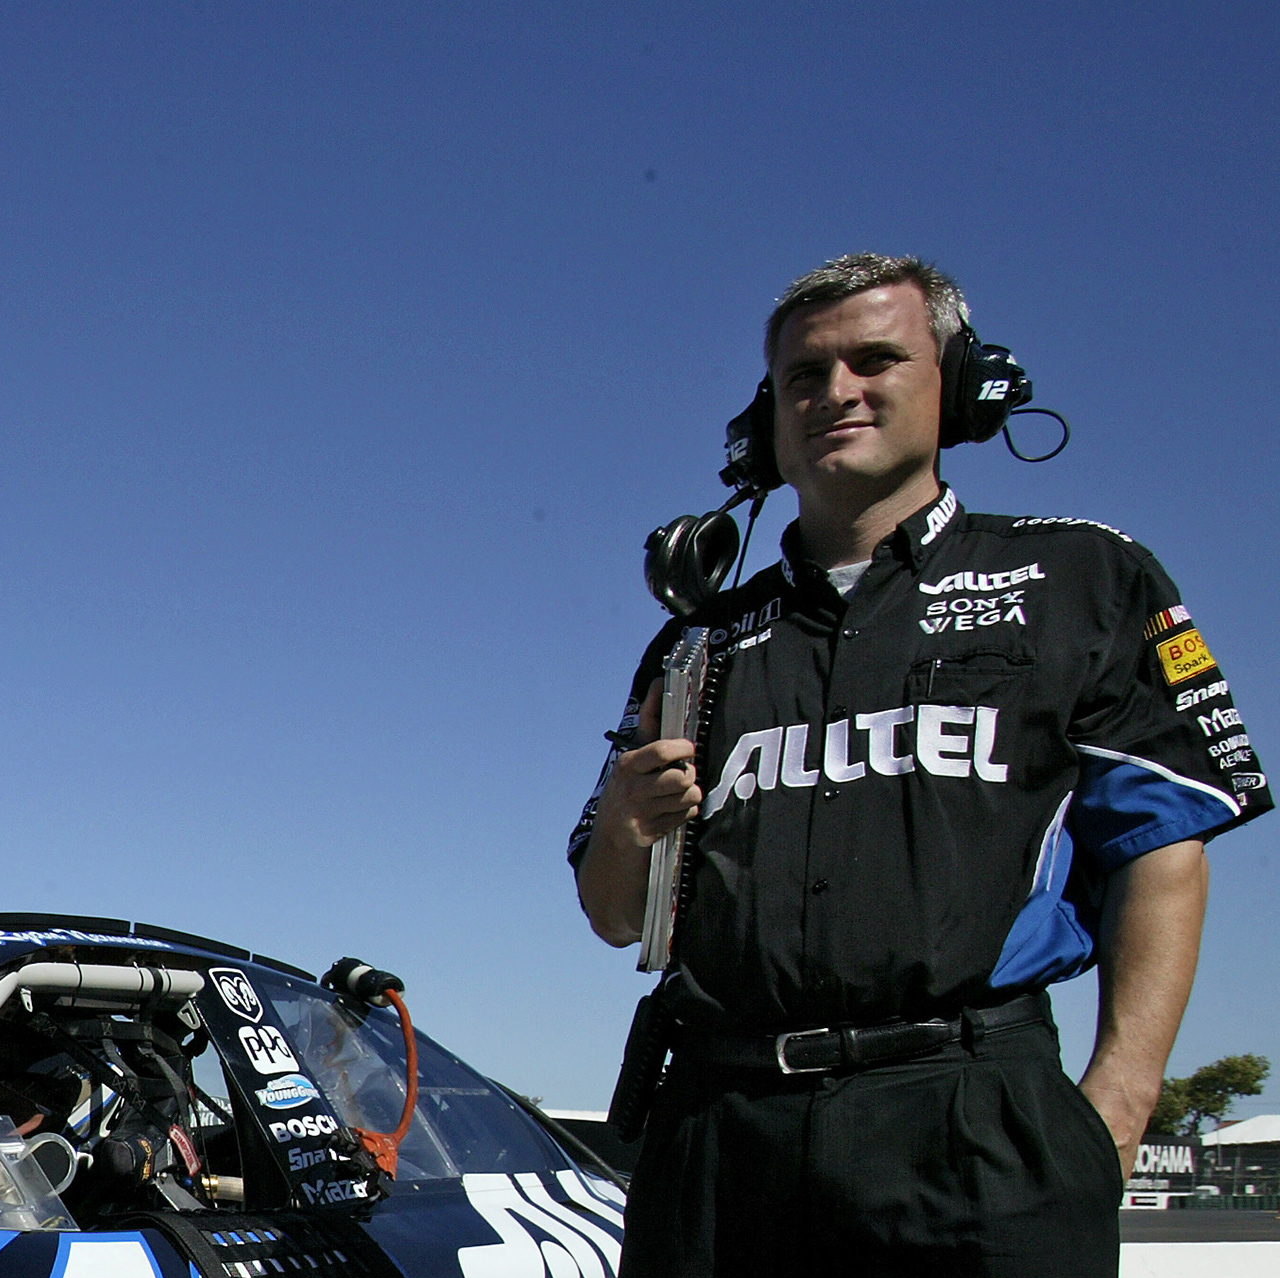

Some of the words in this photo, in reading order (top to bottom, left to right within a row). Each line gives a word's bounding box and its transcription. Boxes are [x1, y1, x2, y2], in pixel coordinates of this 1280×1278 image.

[978, 380, 1010, 400] 12
[918, 562, 1045, 595] ALLTEL
[918, 605, 1026, 634] WEGA
[1169, 635, 1206, 660] BOS
[703, 705, 1009, 820] ALLTEL
[243, 1029, 292, 1064] PPG
[269, 1115, 338, 1143] BOSCH
